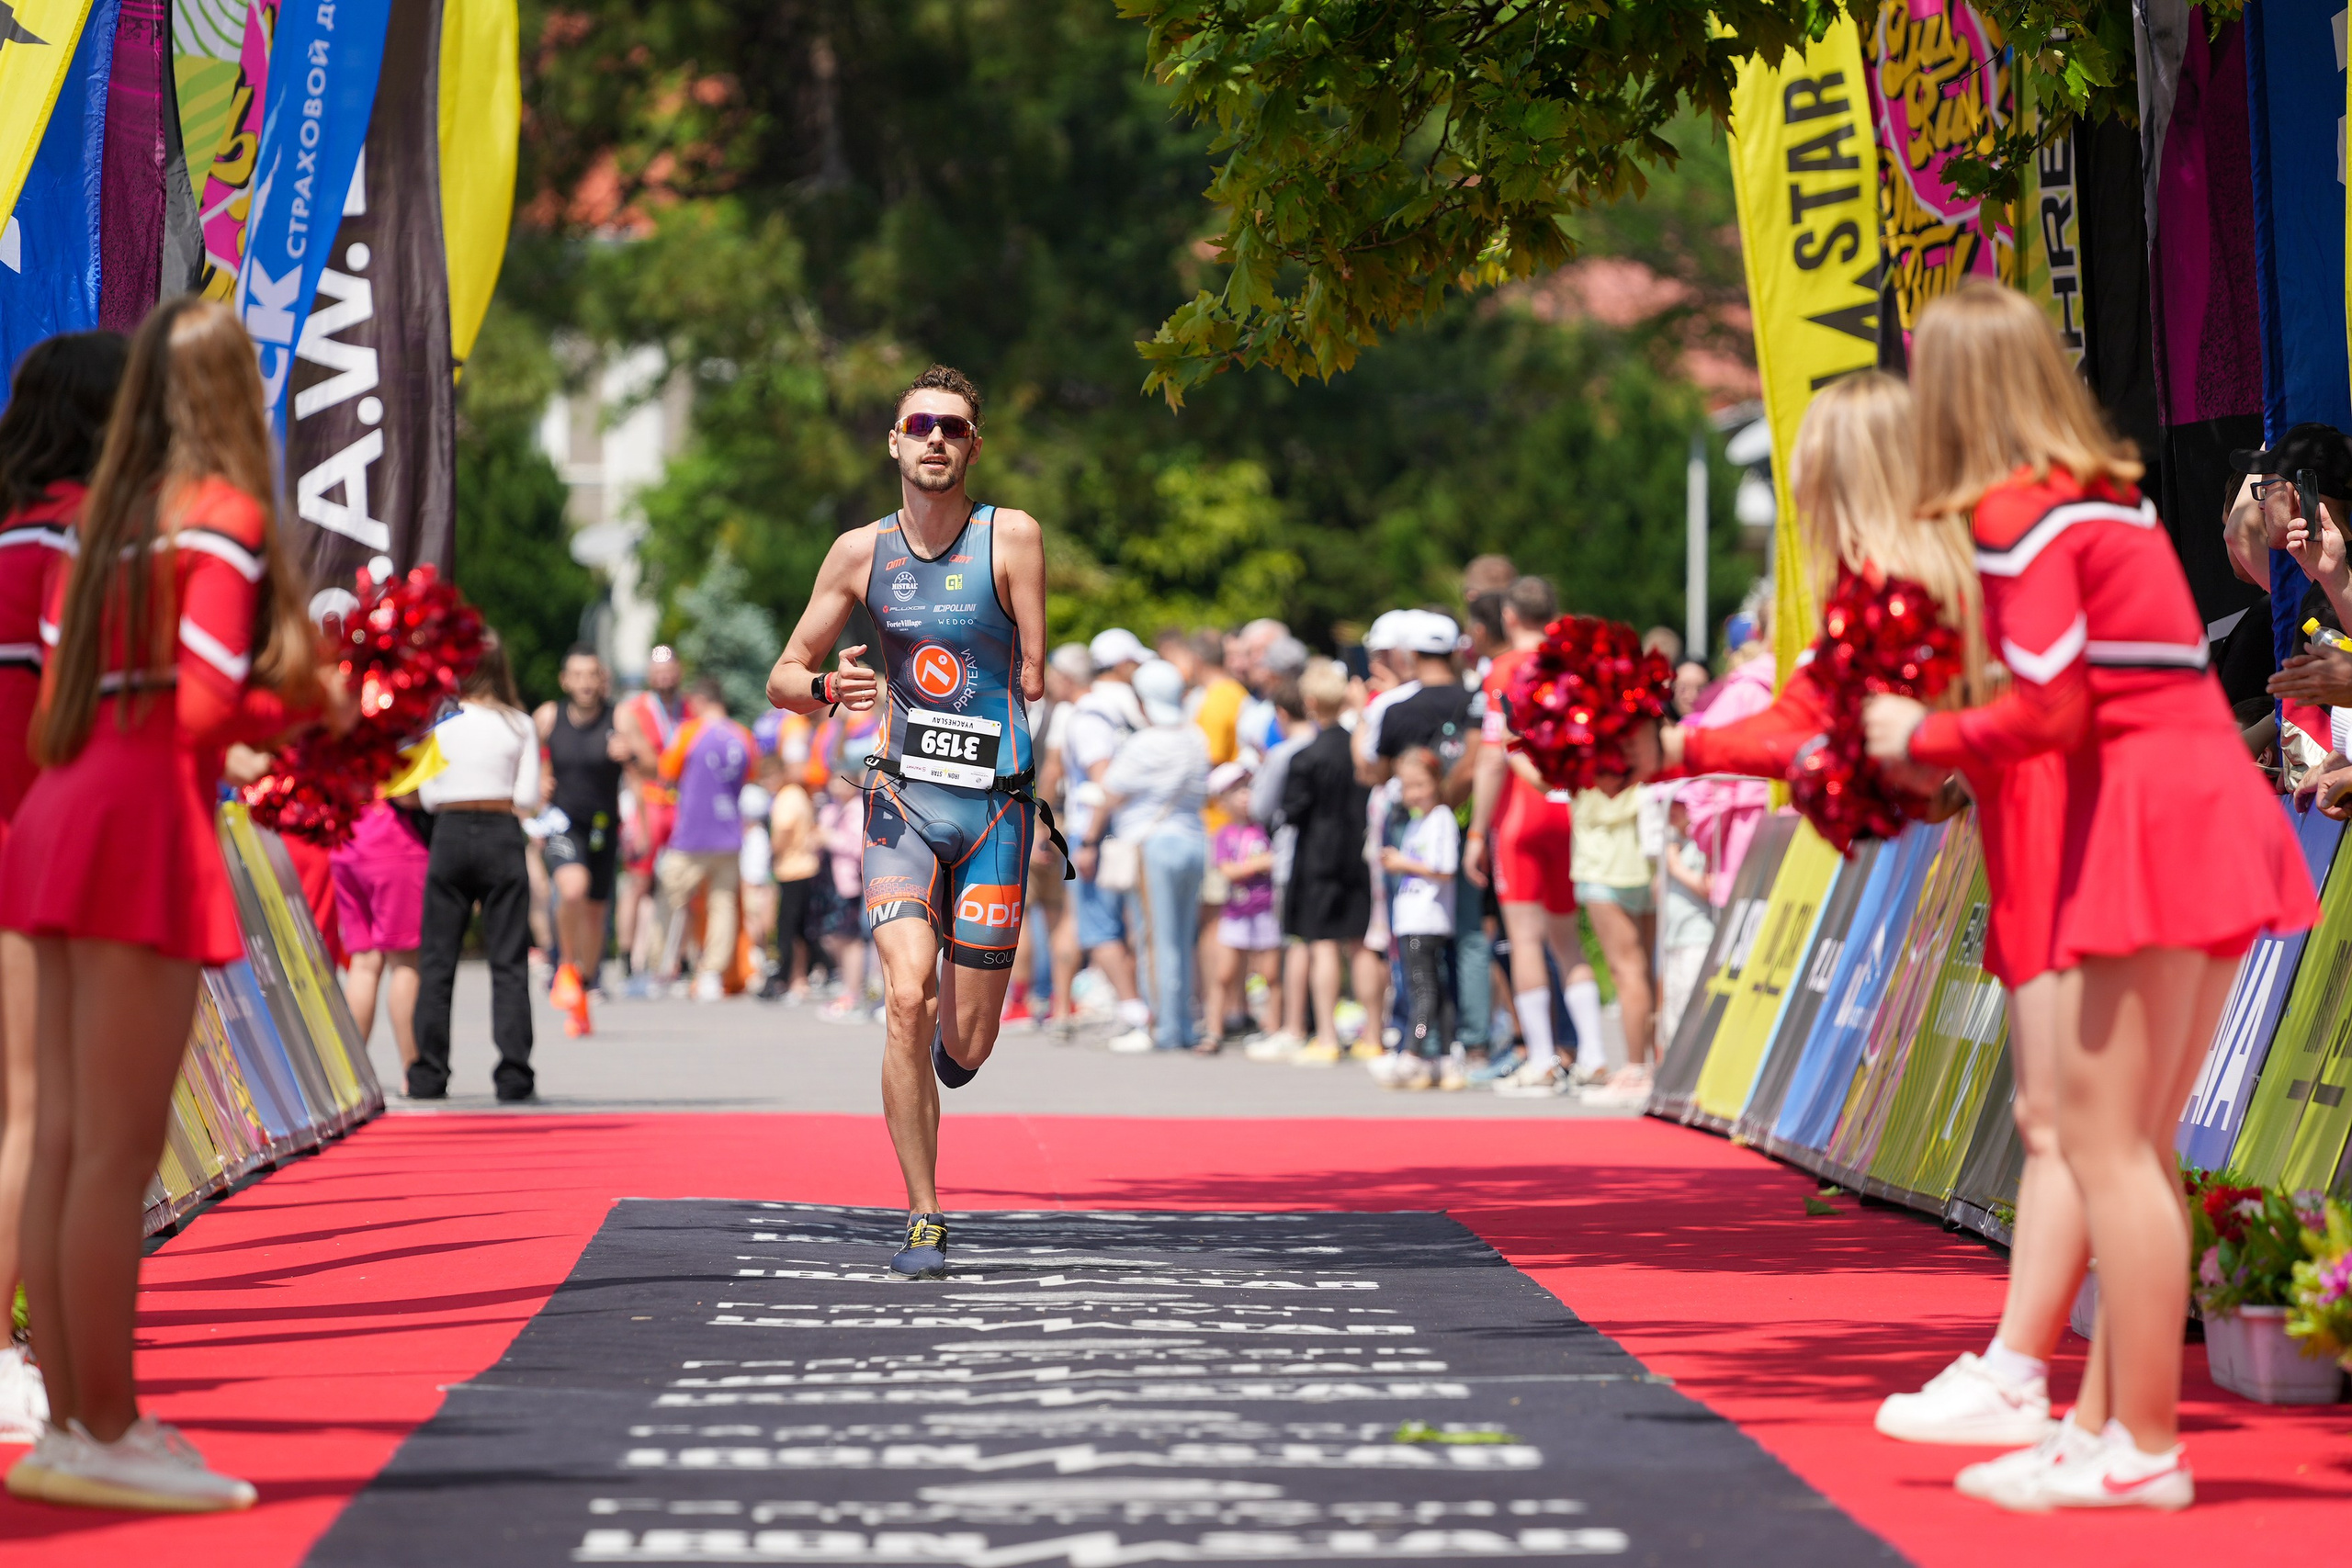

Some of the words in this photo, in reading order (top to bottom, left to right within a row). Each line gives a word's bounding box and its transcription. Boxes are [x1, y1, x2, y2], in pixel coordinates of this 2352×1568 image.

[287, 39, 331, 260] СТРАХОВОЙ
[316, 0, 336, 31] Д
[1783, 71, 1861, 271] STAR
[885, 556, 909, 571] DMT
[949, 554, 974, 564] DMT
[891, 582, 919, 591] MISTRAL
[937, 617, 974, 626] WEDOO
[952, 648, 978, 713] PPRTEAM
[932, 716, 974, 729] VYACHESLAV
[921, 729, 980, 761] 3159
[869, 875, 909, 887] DMT
[982, 951, 1016, 964] SQU
[1117, 1277, 1378, 1289] STAR
[715, 1314, 984, 1325] IRON
[1131, 1319, 1415, 1333] STAR
